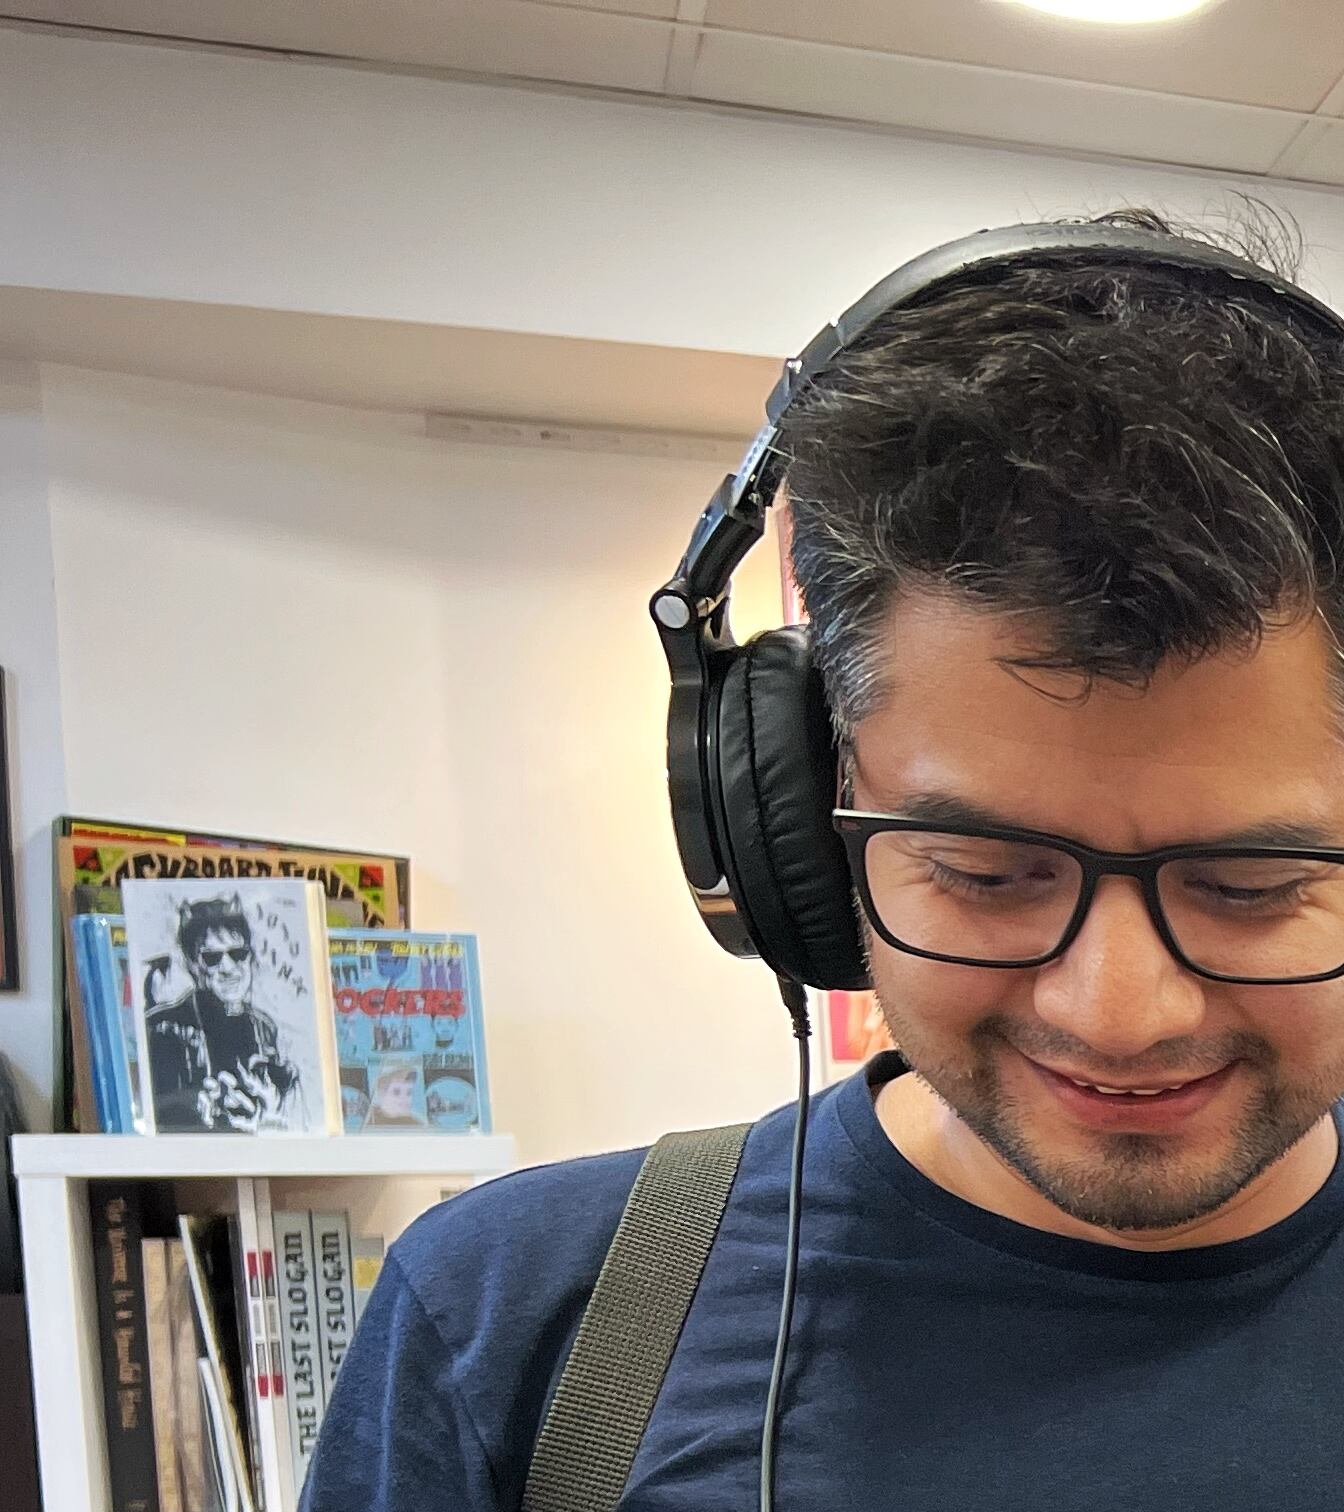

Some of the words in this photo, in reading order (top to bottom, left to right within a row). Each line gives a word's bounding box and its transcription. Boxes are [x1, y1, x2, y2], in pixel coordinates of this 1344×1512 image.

[331, 987, 466, 1017] OCKERS
[283, 1231, 310, 1334] SLOGAN
[321, 1230, 347, 1332] SLOGAN
[290, 1340, 315, 1397] LAST
